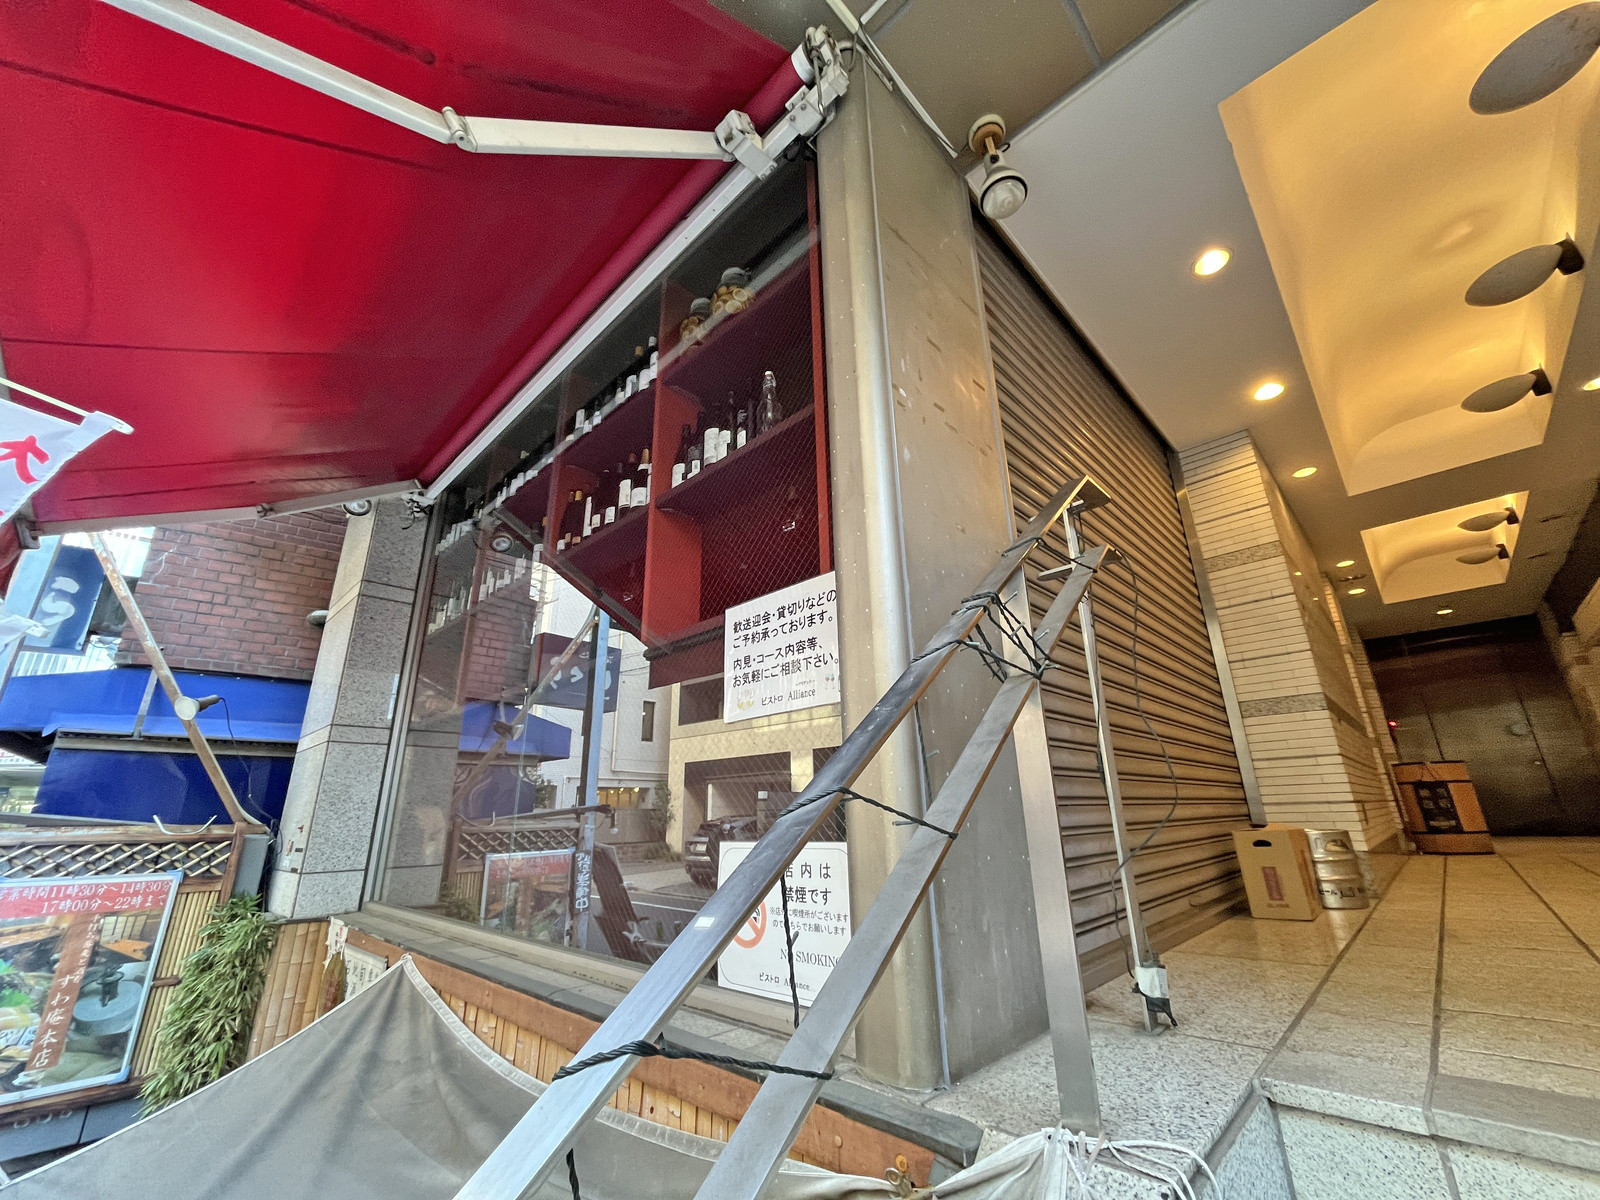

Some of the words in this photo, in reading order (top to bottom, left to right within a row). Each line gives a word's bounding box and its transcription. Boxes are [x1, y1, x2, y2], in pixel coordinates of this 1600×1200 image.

[733, 589, 837, 635] 歓送迎会・貸切りなどの
[733, 609, 833, 649] ご予約承っております。
[733, 636, 823, 672] 内見・コース内容等、
[732, 652, 839, 688] お気軽にご相談下さい。
[761, 695, 783, 706] ビストロ
[788, 689, 816, 701] Alliance
[785, 885, 832, 905] 禁煙です
[772, 919, 847, 936] のでちらでお願いします
[759, 972, 780, 984] ビストロ
